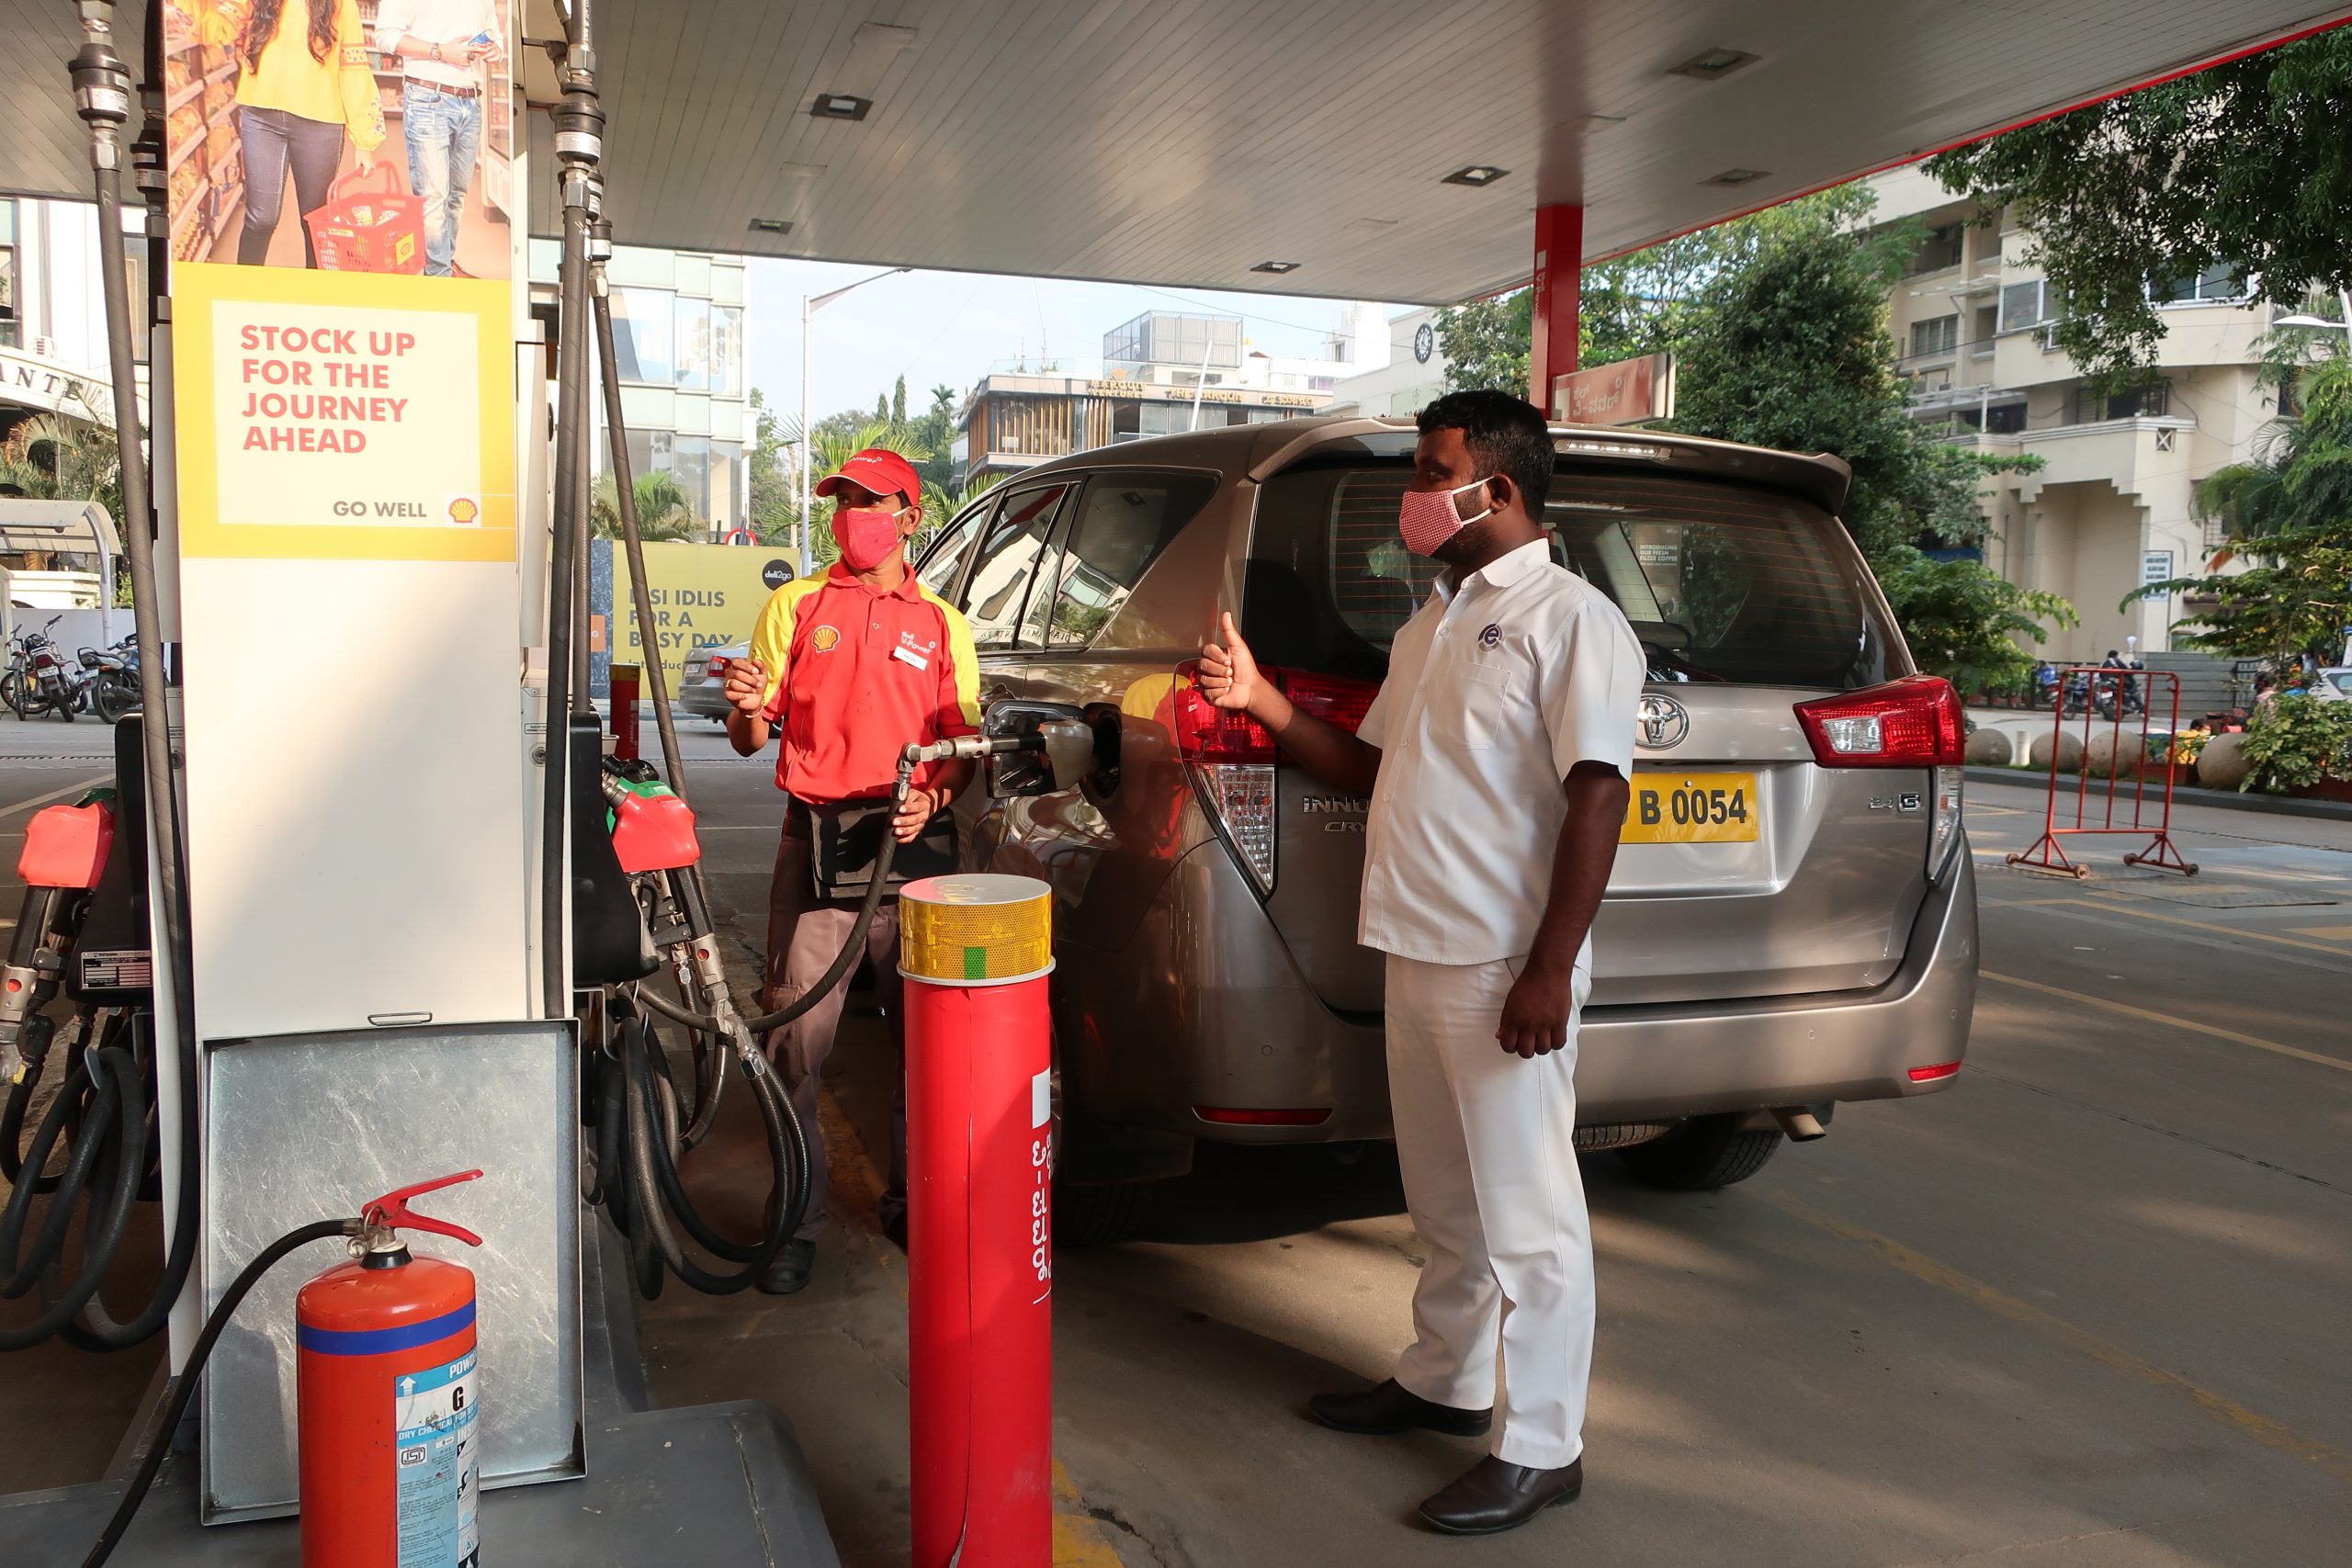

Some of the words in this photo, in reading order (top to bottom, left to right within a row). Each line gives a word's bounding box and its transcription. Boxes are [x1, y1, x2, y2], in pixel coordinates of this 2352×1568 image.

[241, 324, 356, 355] STOCK
[369, 331, 415, 356] UP
[243, 358, 312, 386] FOR
[323, 362, 389, 389] THE
[1090, 389, 1147, 398] VENTURES
[1202, 389, 1245, 402] ARQUIS
[242, 392, 409, 423] JOURNEY
[243, 426, 367, 454] AHEAD
[333, 501, 368, 516] GO
[374, 502, 427, 517] WELL
[764, 570, 792, 581] deli2go
[629, 588, 667, 604] SI
[675, 590, 725, 607] IDLIS
[629, 609, 671, 626] FR
[678, 611, 693, 627] A
[629, 631, 684, 649] BSY
[692, 633, 733, 649] DAY
[1639, 789, 1661, 825] B
[1671, 789, 1747, 825] 0054
[399, 1430, 416, 1440] DRY
